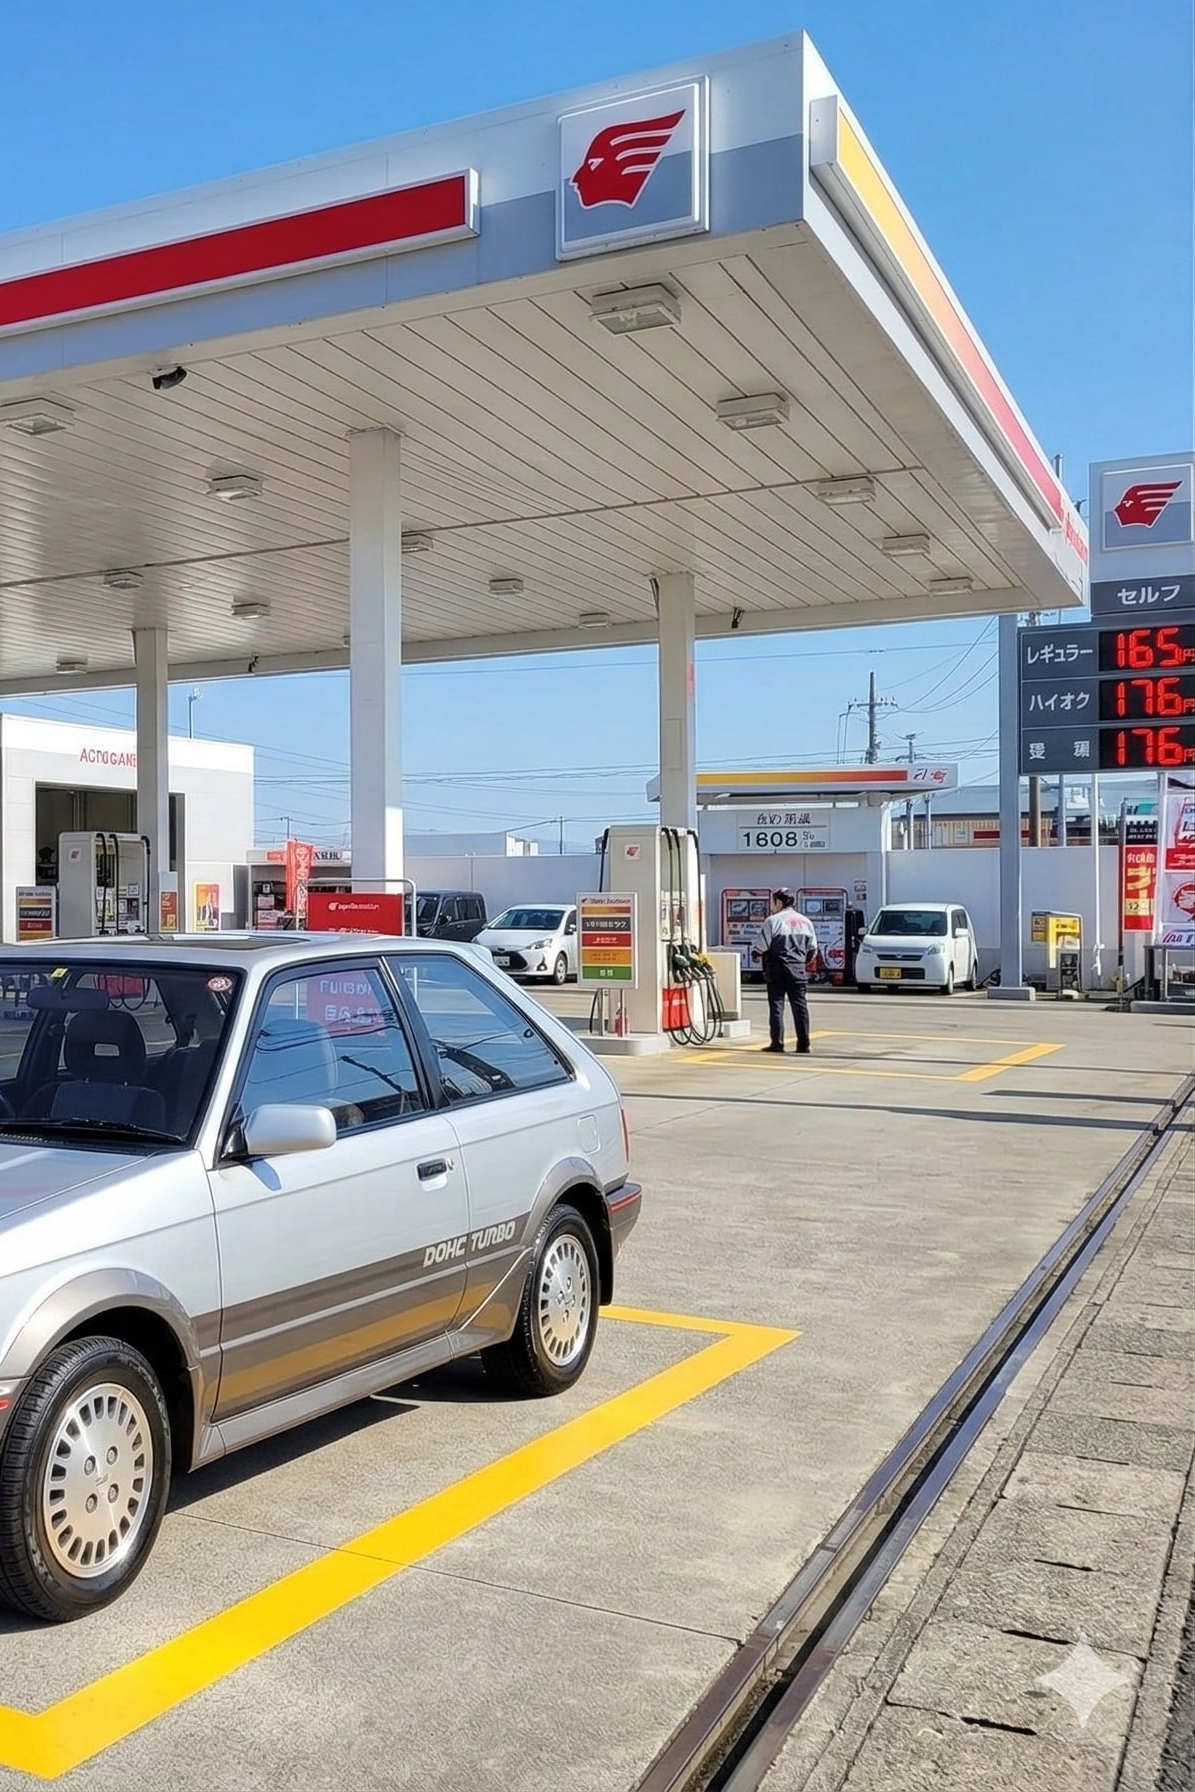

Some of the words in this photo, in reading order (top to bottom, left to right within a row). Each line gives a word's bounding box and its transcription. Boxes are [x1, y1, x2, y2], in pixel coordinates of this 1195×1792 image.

[1117, 585, 1180, 605] セルフ
[1027, 643, 1094, 665] レギュラー
[1029, 692, 1091, 712] ハイオク
[743, 831, 798, 848] 1608
[423, 1236, 467, 1268] DOHC
[470, 1220, 516, 1252] TURBO
